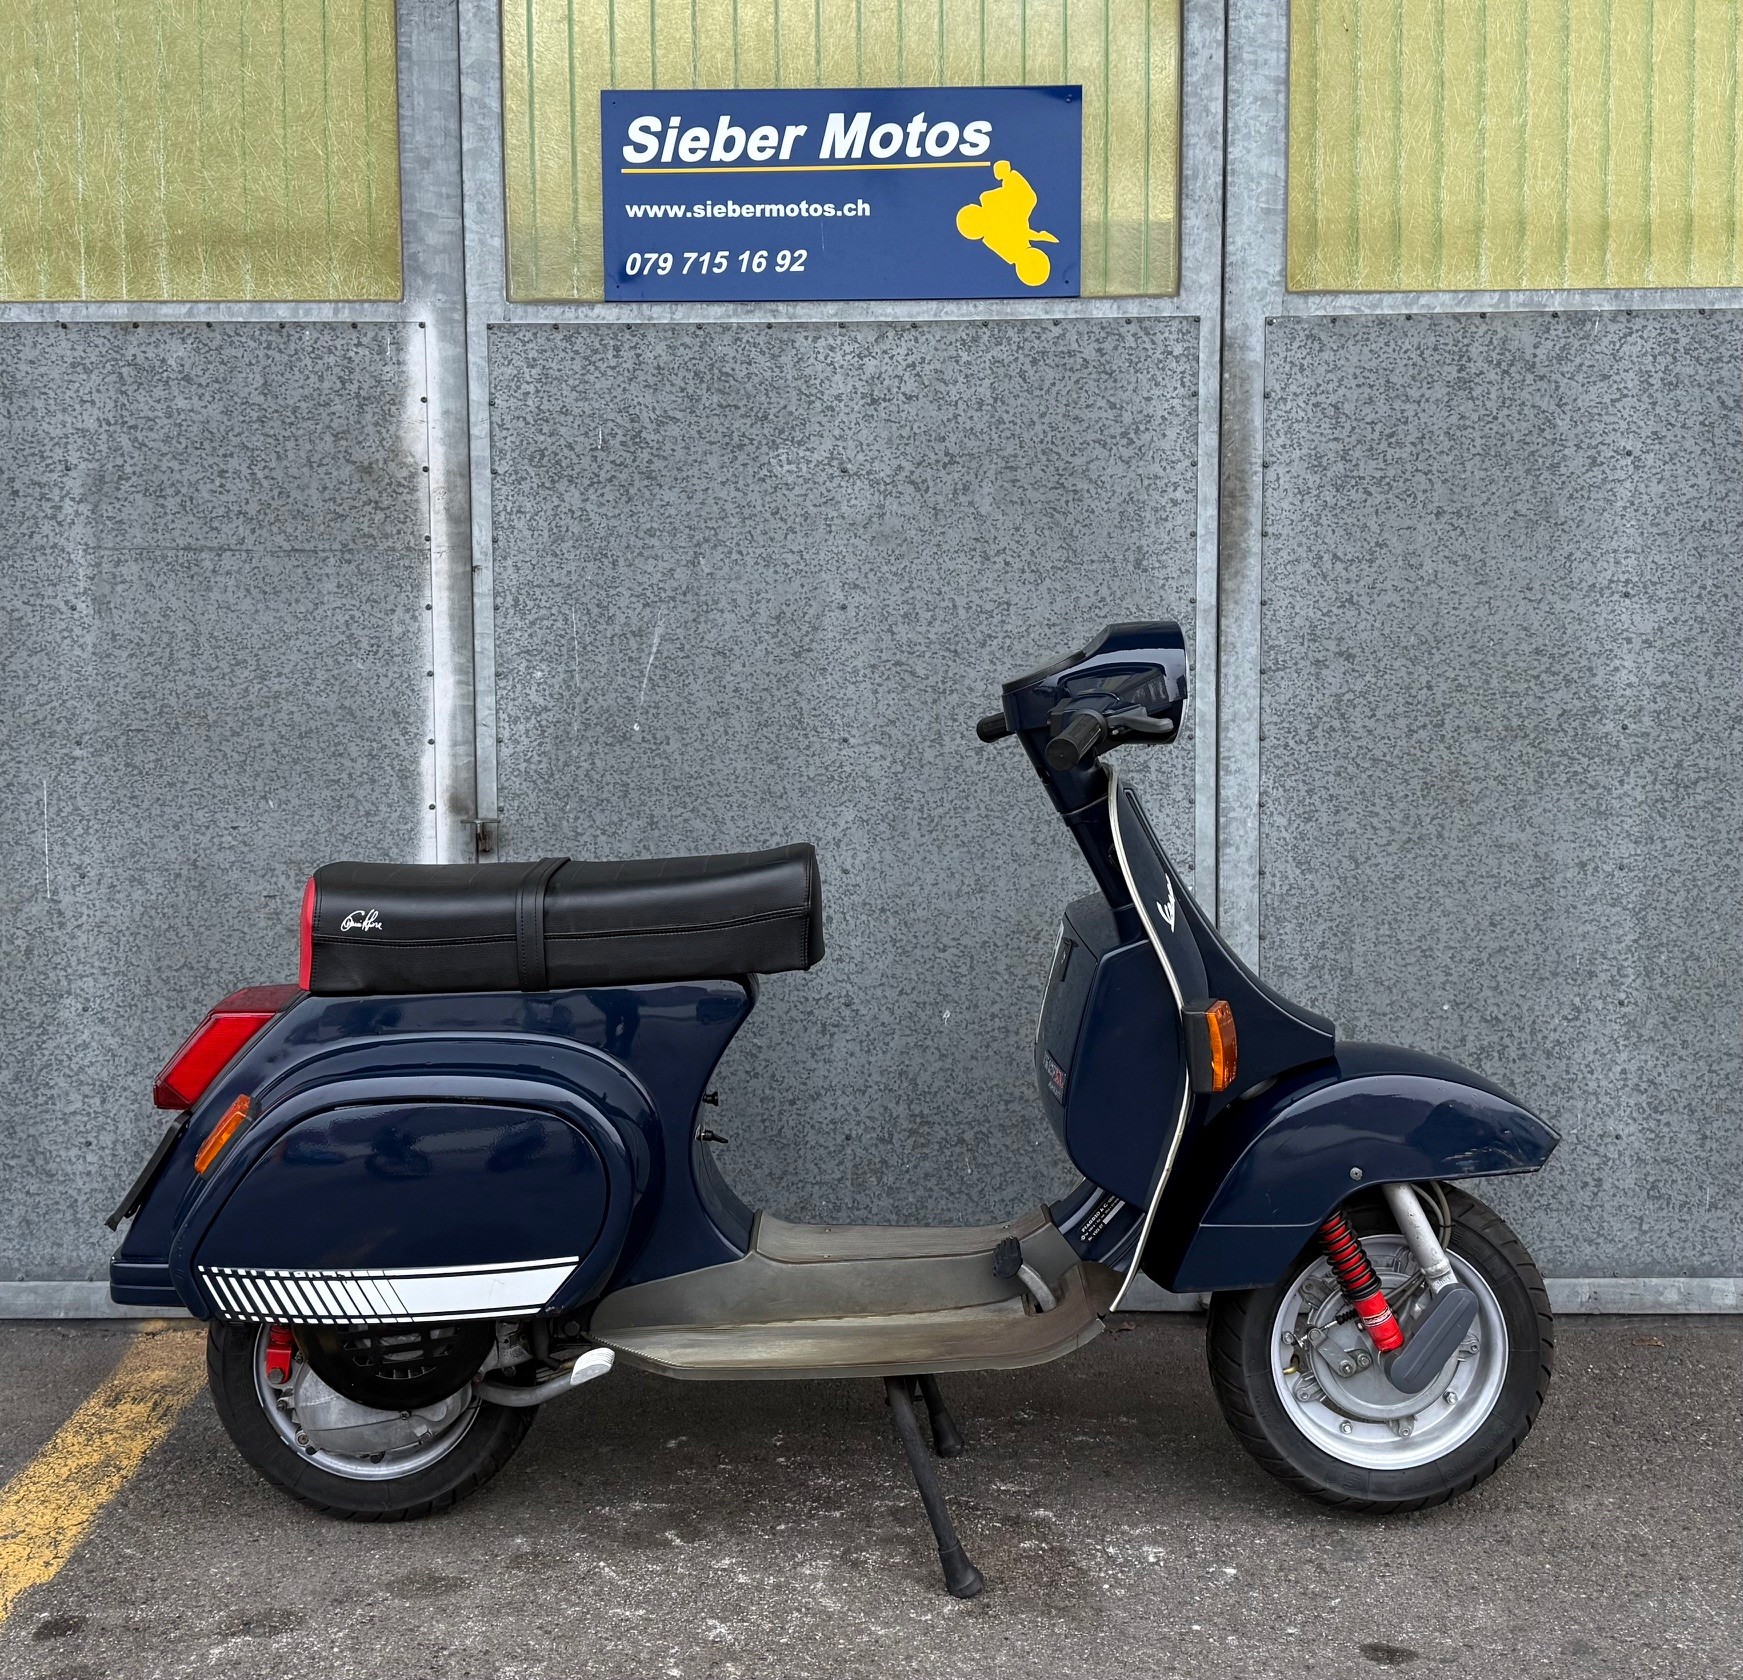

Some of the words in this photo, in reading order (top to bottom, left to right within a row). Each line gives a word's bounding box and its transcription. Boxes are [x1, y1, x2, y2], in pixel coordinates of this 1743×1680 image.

[622, 114, 808, 164] Sieber
[818, 111, 993, 160] Motos
[624, 198, 872, 218] www.siebermotos.ch
[624, 252, 674, 276] 079
[681, 250, 730, 275] 715
[737, 250, 769, 274] 16
[774, 249, 808, 273] 92
